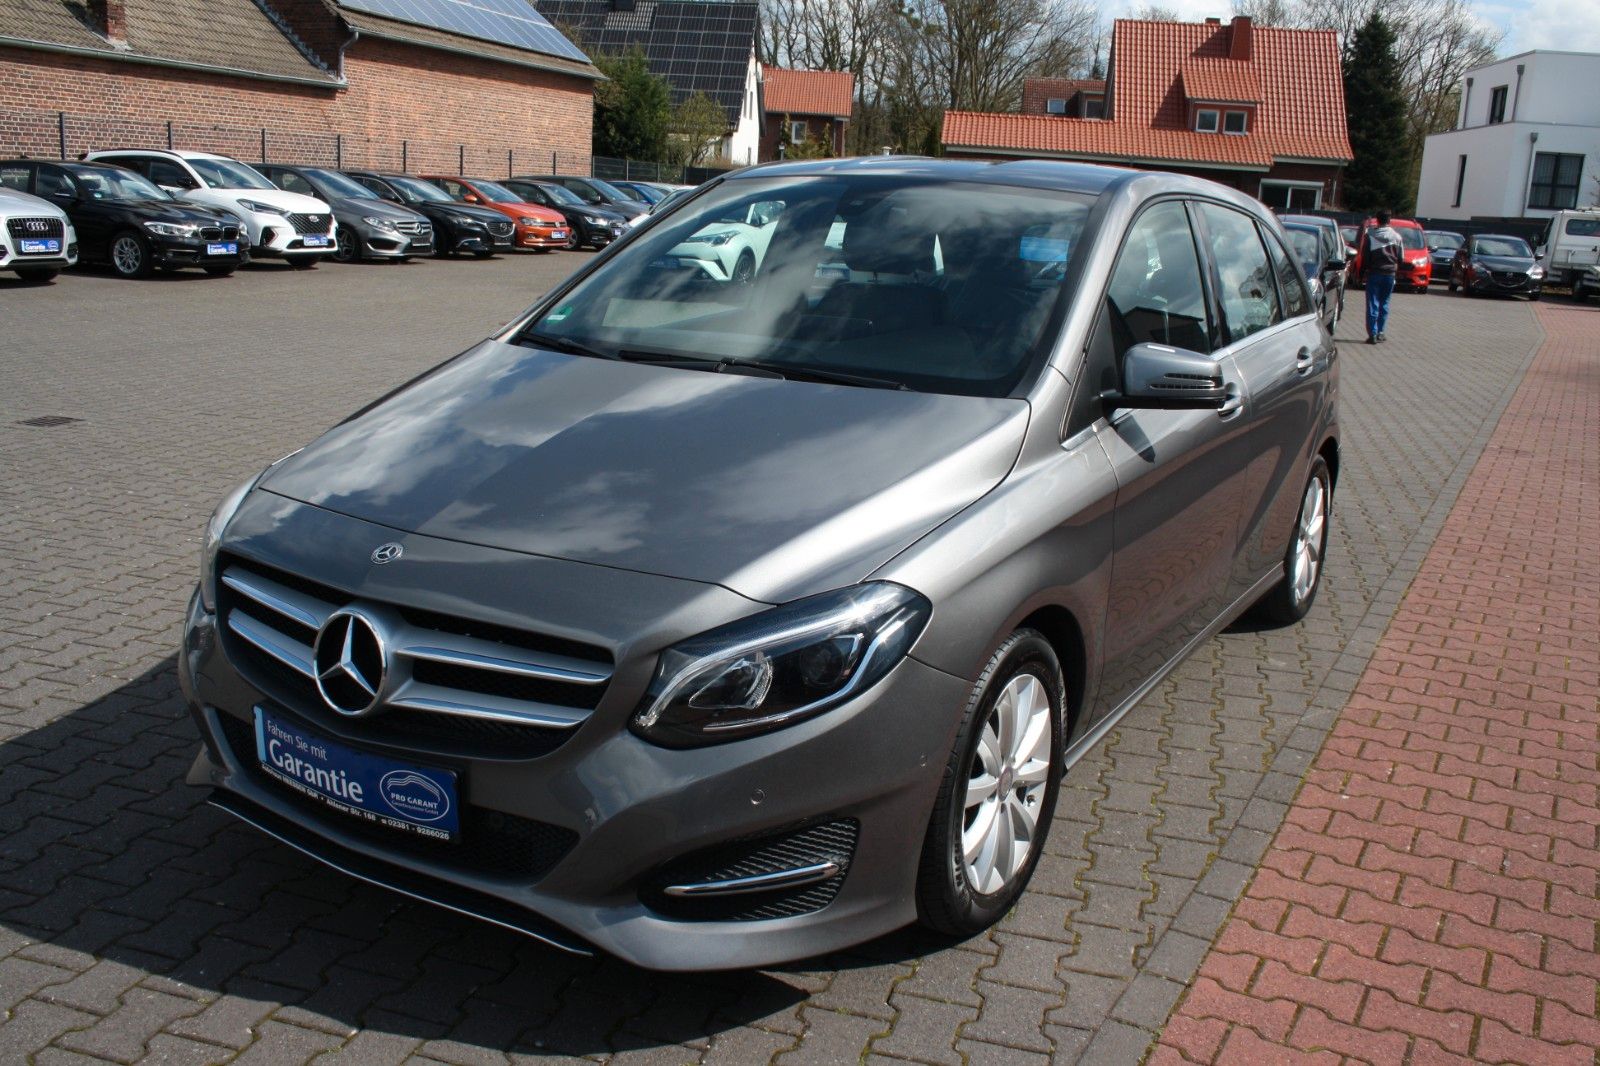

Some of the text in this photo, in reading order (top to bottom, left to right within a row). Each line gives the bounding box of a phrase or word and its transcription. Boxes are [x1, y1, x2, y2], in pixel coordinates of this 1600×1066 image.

[267, 720, 328, 761] Fahren Sie mit
[269, 739, 364, 803] Garantie
[391, 792, 406, 802] PRO
[407, 797, 438, 809] GARANT
[387, 819, 409, 830] 02381
